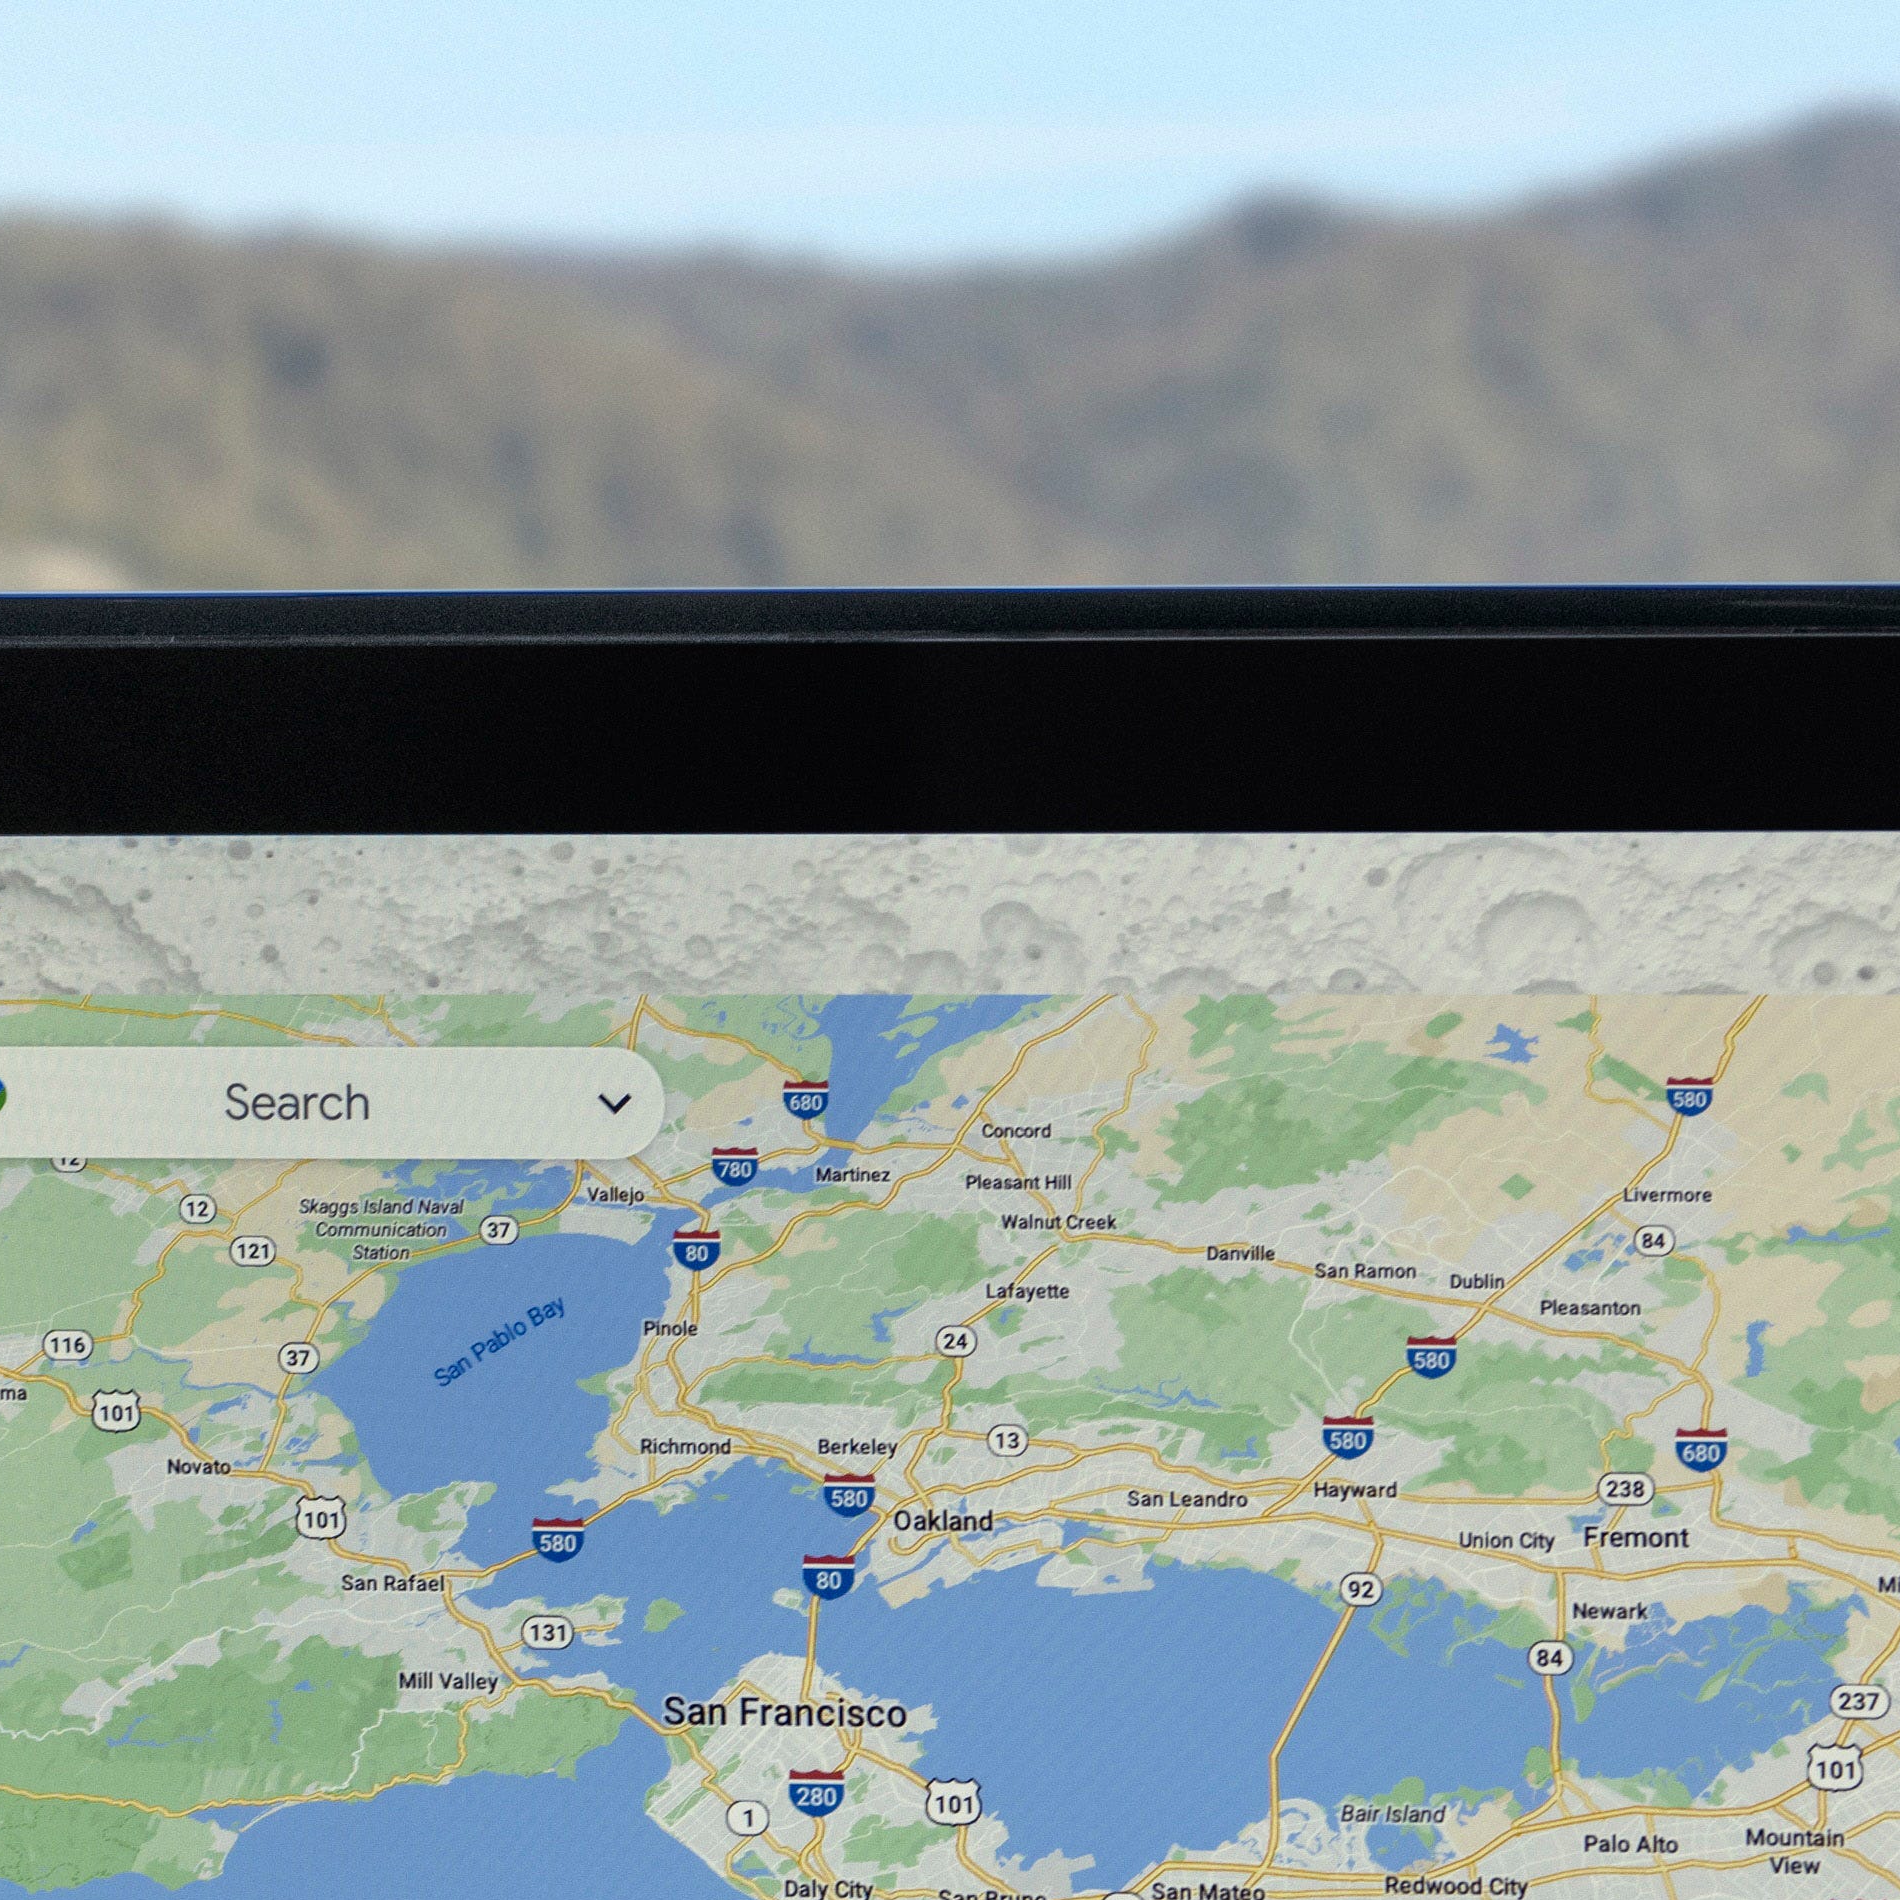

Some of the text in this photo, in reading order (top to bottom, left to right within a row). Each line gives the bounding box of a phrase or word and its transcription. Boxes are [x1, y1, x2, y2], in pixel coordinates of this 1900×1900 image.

[224, 1082, 371, 1122] Search
[789, 1095, 823, 1112] 680
[1673, 1091, 1707, 1108] 580
[981, 1122, 1052, 1139] Concord
[718, 1161, 752, 1178] 780
[816, 1166, 891, 1183] Martinez
[965, 1174, 1072, 1191] Pleasant Hill
[587, 1186, 645, 1206] Vallejo
[1622, 1186, 1713, 1203] Livermore
[186, 1199, 209, 1218] 12
[299, 1198, 465, 1217] Skaggs Island Naval
[315, 1221, 448, 1239] Communication
[487, 1222, 511, 1239] 37
[1001, 1214, 1118, 1231] Walnut Creek
[1641, 1233, 1666, 1250] 84
[236, 1242, 272, 1260] 121
[353, 1244, 411, 1261] Station
[686, 1245, 709, 1262] 80
[1206, 1245, 1276, 1262] Danville
[1314, 1263, 1417, 1280] San Ramon
[1450, 1273, 1505, 1290] Dublin
[985, 1283, 1070, 1302] Lafayette
[1540, 1300, 1642, 1317] Pleasanton
[643, 1320, 699, 1337] Pinole
[49, 1336, 87, 1355] 116
[434, 1297, 567, 1389] San Pablo Bay
[943, 1333, 968, 1350] 24
[286, 1349, 311, 1368] 37
[1414, 1353, 1450, 1371] 580
[100, 1405, 133, 1423] 101
[640, 1438, 732, 1456] Richmond
[817, 1438, 899, 1459] Berkeley
[995, 1432, 1020, 1450] 13
[1329, 1432, 1367, 1450] 580
[1682, 1445, 1720, 1463] 680
[167, 1458, 231, 1476] Novato
[1314, 1481, 1398, 1503] Hayward
[1606, 1480, 1644, 1498] 238
[831, 1490, 868, 1508] 580
[1127, 1490, 1249, 1508] San Leandro
[304, 1512, 340, 1530] 101
[893, 1510, 994, 1532] Oakland
[540, 1535, 577, 1553] 580
[1459, 1532, 1556, 1554] Union City
[1583, 1527, 1690, 1549] Fremont
[341, 1574, 446, 1592] San Rafael
[816, 1572, 842, 1590] 80
[1348, 1581, 1374, 1599] 92
[1572, 1603, 1649, 1620] Newark
[530, 1624, 567, 1641] 131
[1537, 1649, 1563, 1668] 84
[399, 1673, 499, 1695] Mill Valley
[1838, 1693, 1880, 1712] 237
[663, 1697, 908, 1728] San Francisco
[1816, 1762, 1855, 1780] 101
[796, 1787, 837, 1807] 280
[935, 1795, 974, 1814] 101
[742, 1809, 754, 1829] 1
[1340, 1805, 1446, 1824] Bair Island
[1583, 1835, 1679, 1854] Palo Alto
[1745, 1828, 1846, 1848] Mountain
[1769, 1856, 1821, 1876] View
[1385, 1877, 1530, 1900] Redwood City
